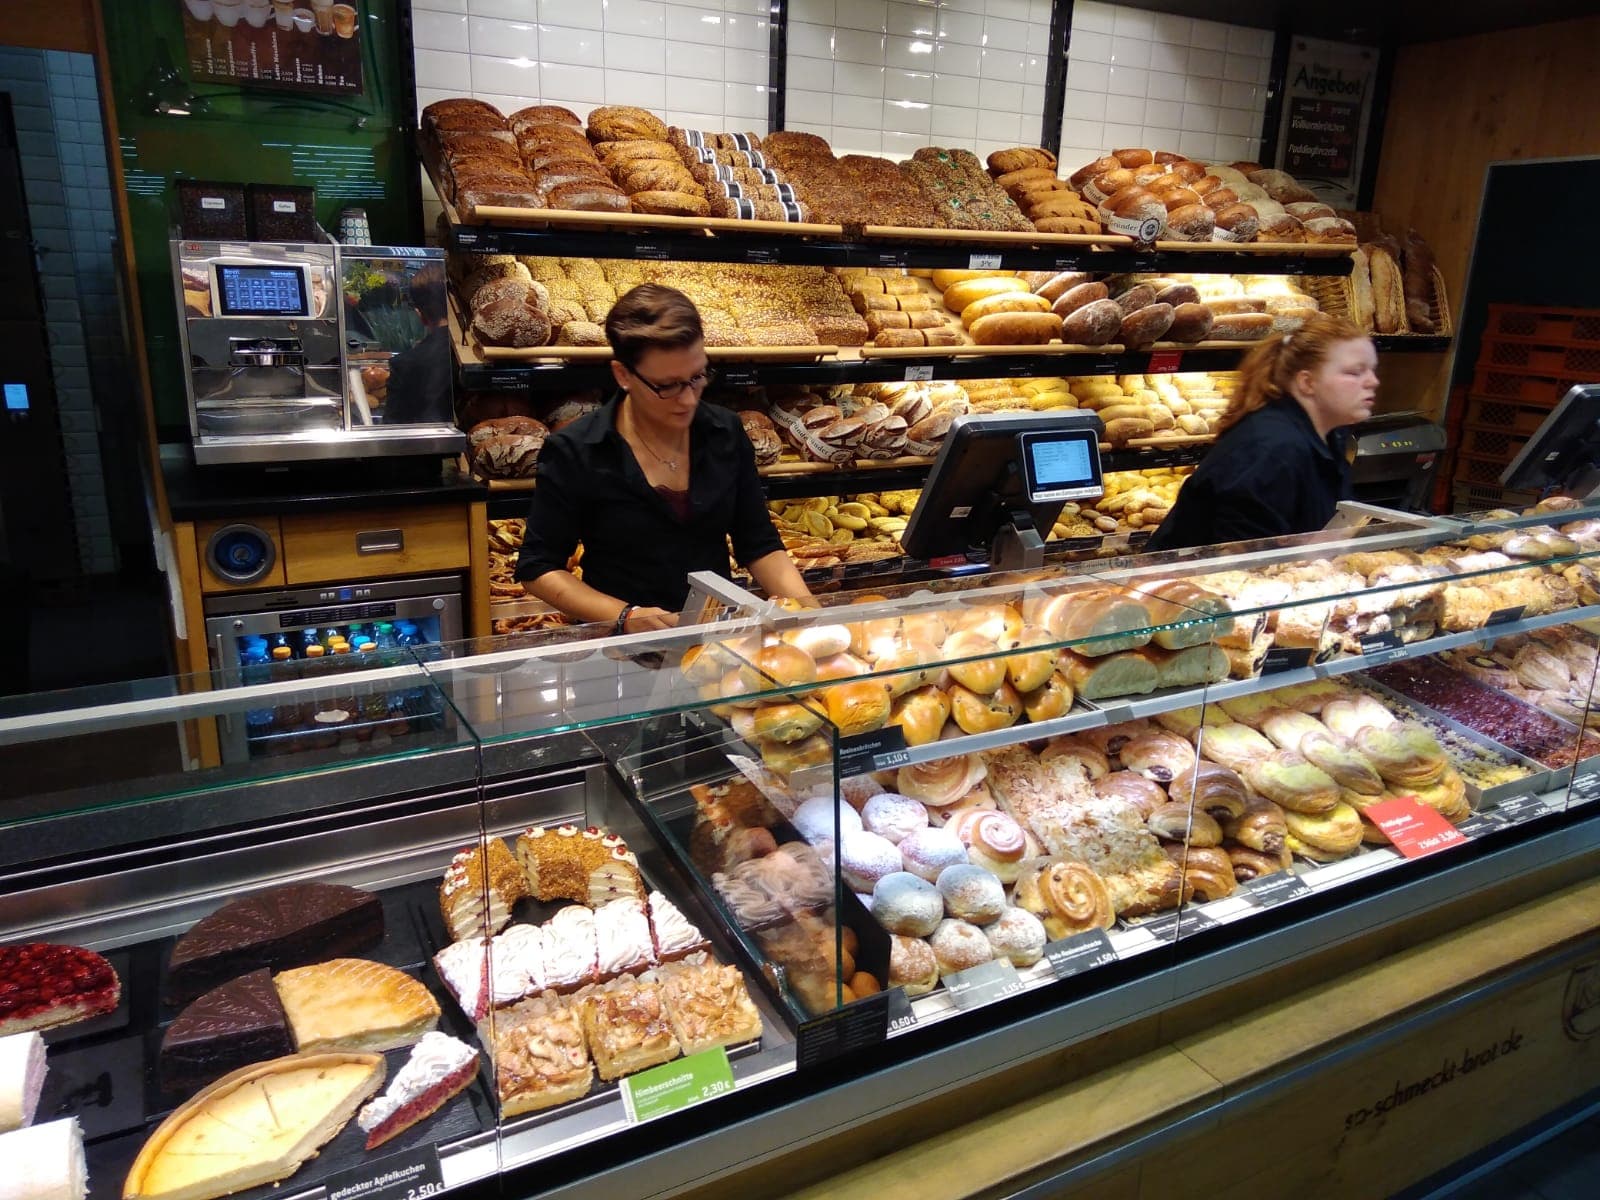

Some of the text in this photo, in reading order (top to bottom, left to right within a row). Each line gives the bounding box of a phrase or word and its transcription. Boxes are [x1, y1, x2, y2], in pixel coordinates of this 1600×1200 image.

[634, 1072, 694, 1099] Himbeerschnitte
[330, 1179, 373, 1200] gedeckter
[374, 1162, 426, 1187] Apfelkuchen
